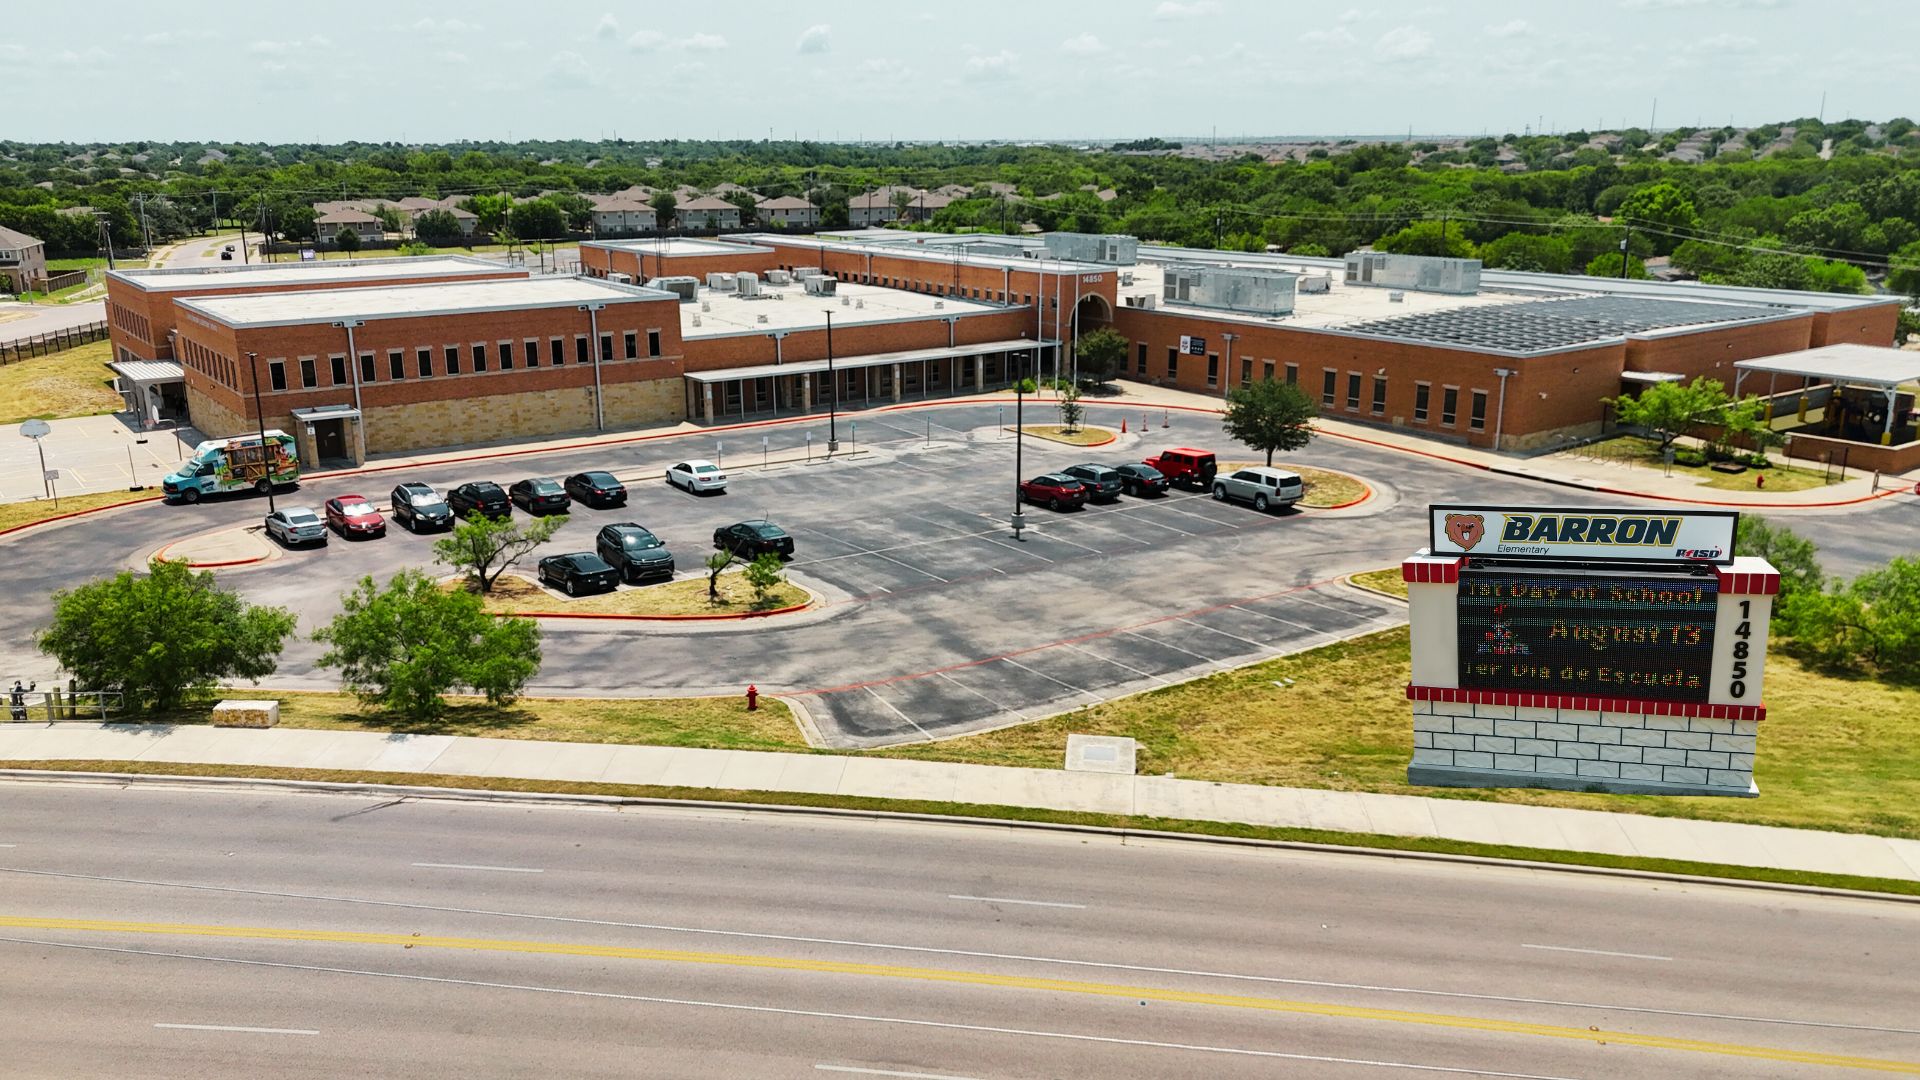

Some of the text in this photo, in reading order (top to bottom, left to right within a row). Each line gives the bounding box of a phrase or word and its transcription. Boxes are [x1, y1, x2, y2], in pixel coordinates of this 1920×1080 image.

[1502, 516, 1683, 546] BARRON
[1497, 544, 1550, 555] Elementary
[1511, 582, 1561, 606] Day
[1571, 584, 1600, 601] of
[1610, 585, 1701, 604] School
[1549, 619, 1700, 650] August 13
[1730, 600, 1751, 698] 14850
[1560, 663, 1590, 681] de
[1598, 667, 1702, 689] Escuela
